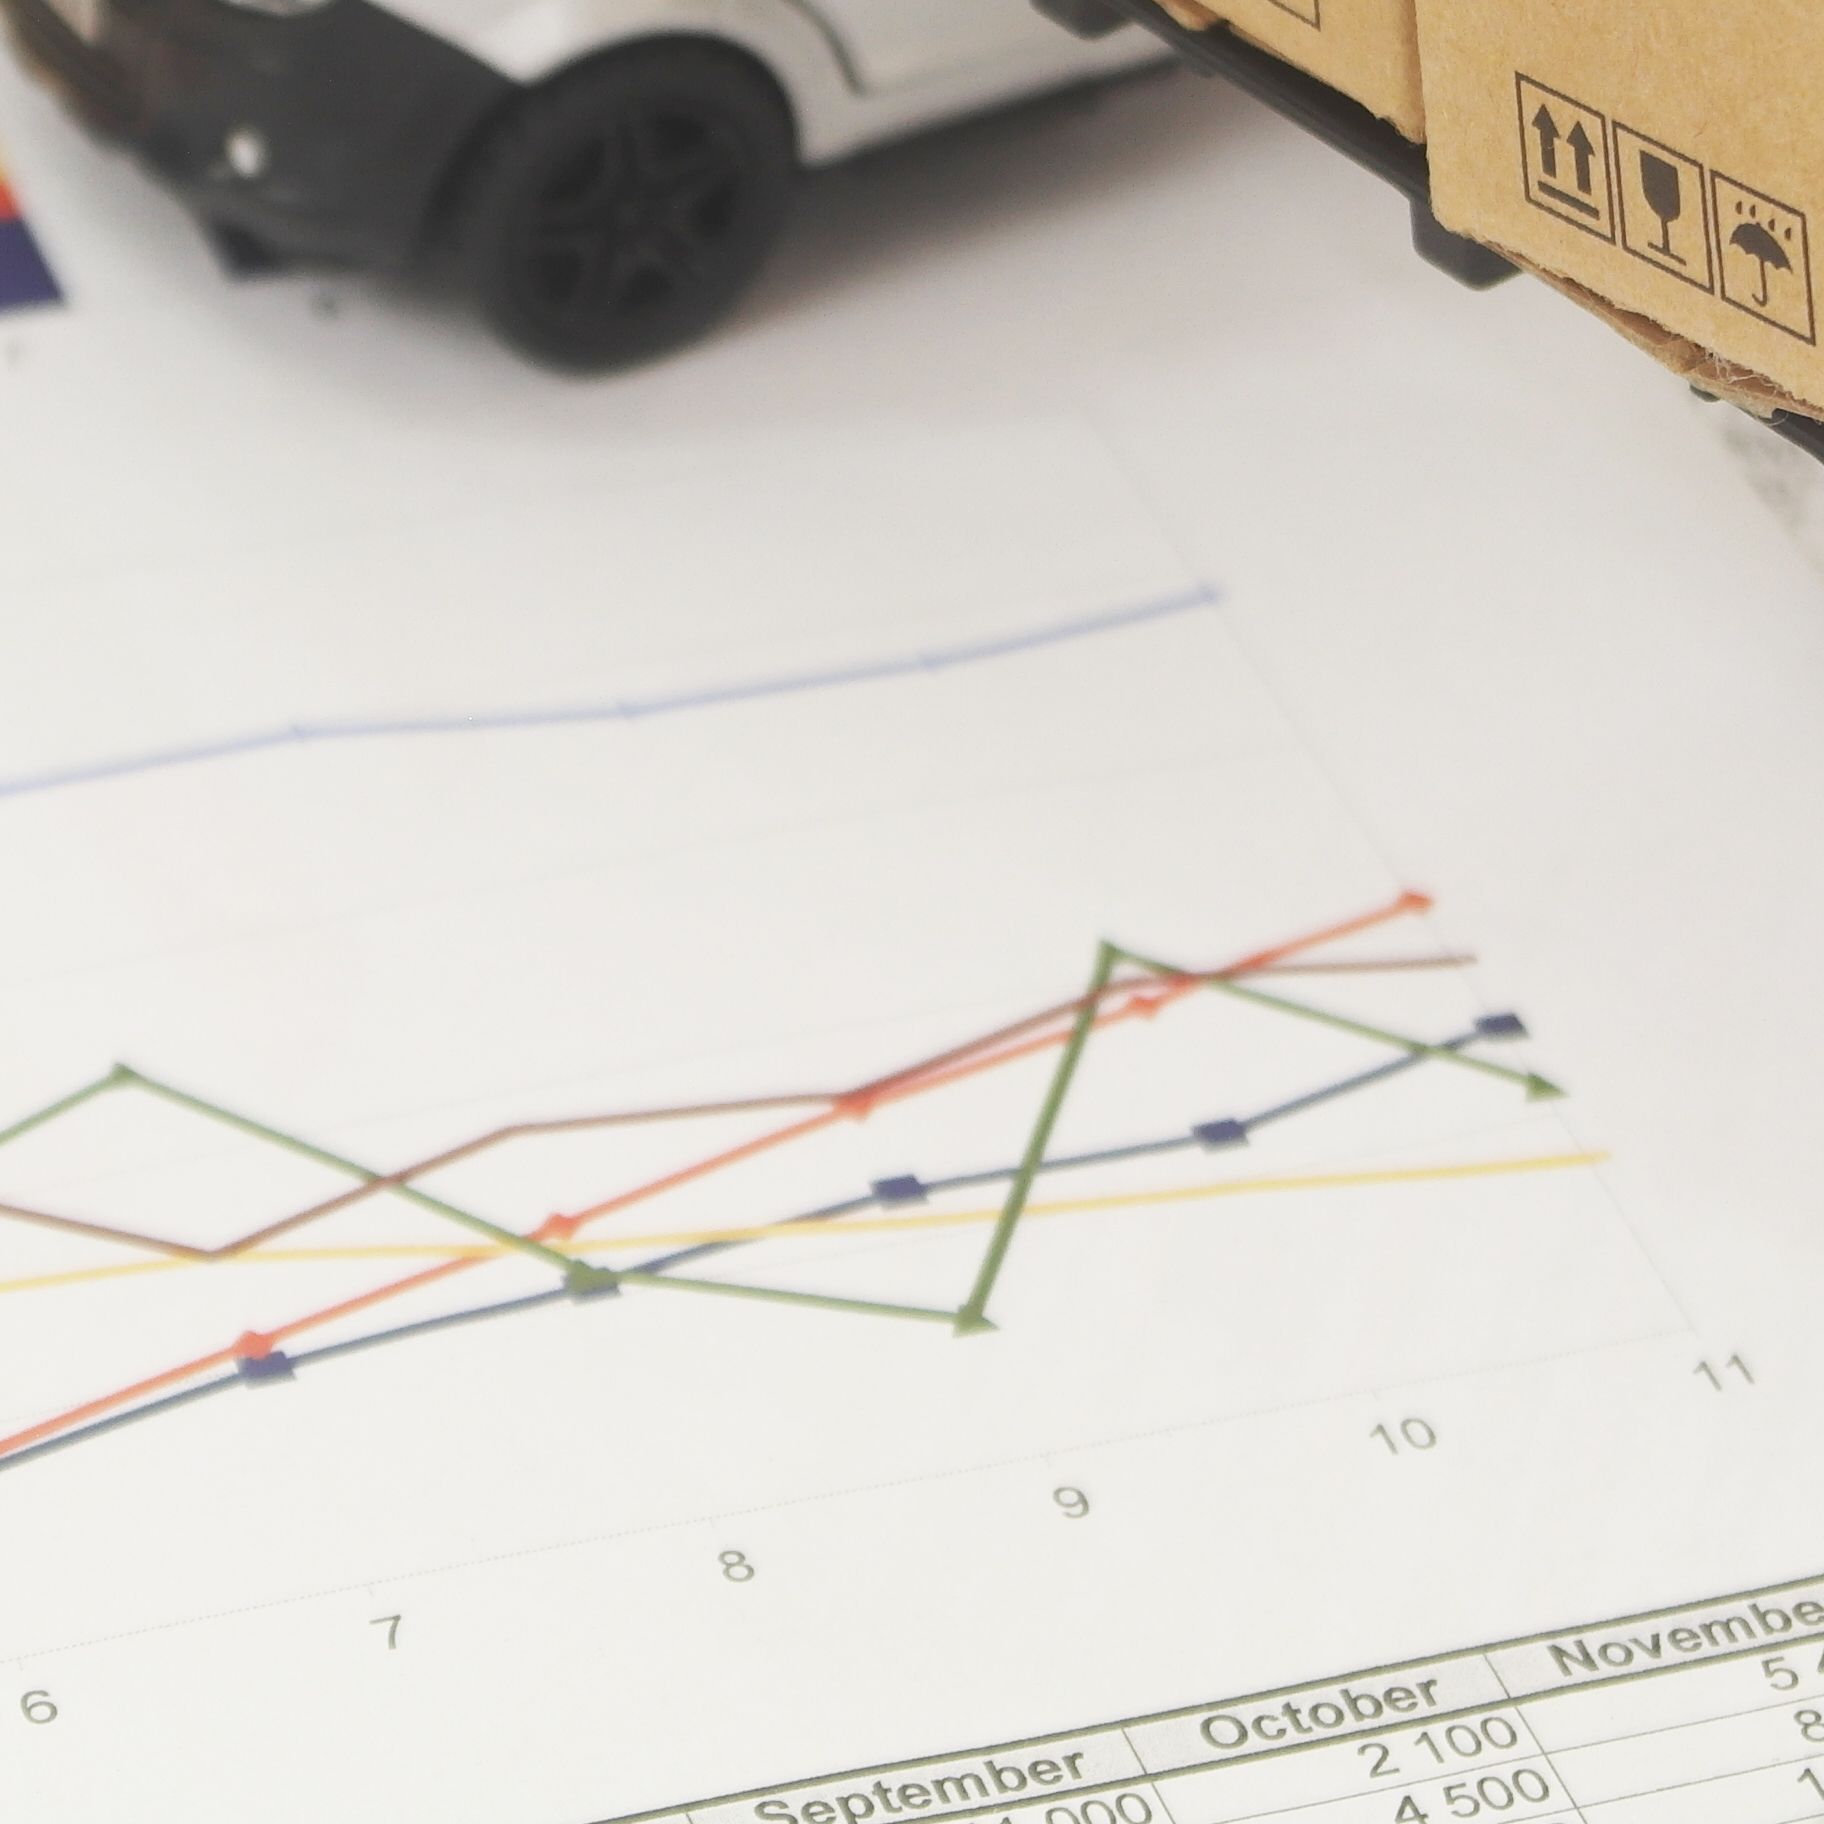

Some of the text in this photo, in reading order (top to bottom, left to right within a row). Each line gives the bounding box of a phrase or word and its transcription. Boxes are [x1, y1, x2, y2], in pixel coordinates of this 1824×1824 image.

[19, 1688, 59, 1726] 6
[369, 1612, 403, 1651] 7
[717, 1548, 757, 1584] 8
[1051, 1485, 1091, 1520] 9
[1369, 1416, 1438, 1455] 10
[1692, 1353, 1755, 1392] 11
[753, 1751, 1083, 1824] September
[1199, 1678, 1438, 1750] October
[1357, 1743, 1400, 1778] 2
[1414, 1716, 1519, 1764] 100
[1761, 1656, 1800, 1692] 5
[1394, 1794, 1429, 1824] 4
[1443, 1768, 1551, 1819] 500
